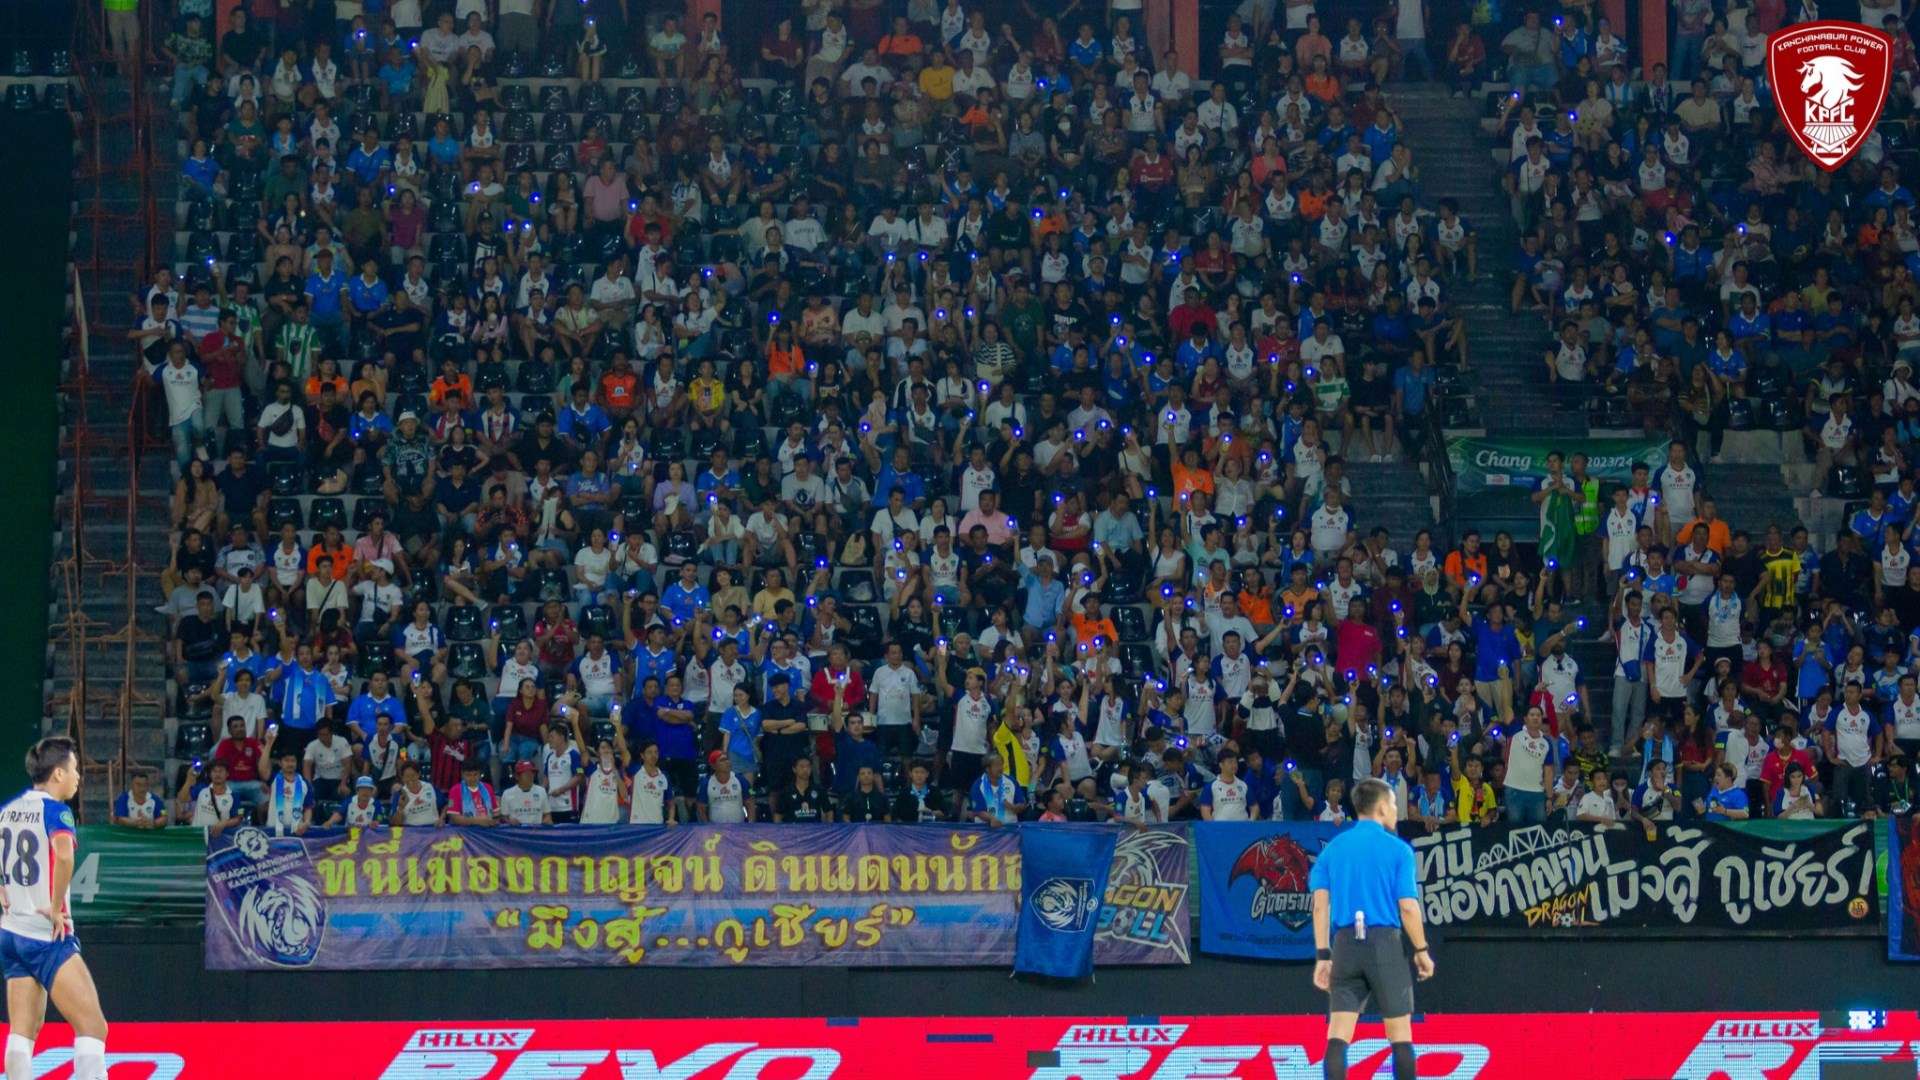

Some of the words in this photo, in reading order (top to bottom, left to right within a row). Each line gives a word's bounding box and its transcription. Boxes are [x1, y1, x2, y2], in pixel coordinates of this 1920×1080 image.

[1475, 450, 1532, 471] Chang
[1073, 1028, 1173, 1042] HILUX
[1717, 1022, 1816, 1037] HILUX
[418, 1032, 520, 1047] HILUX
